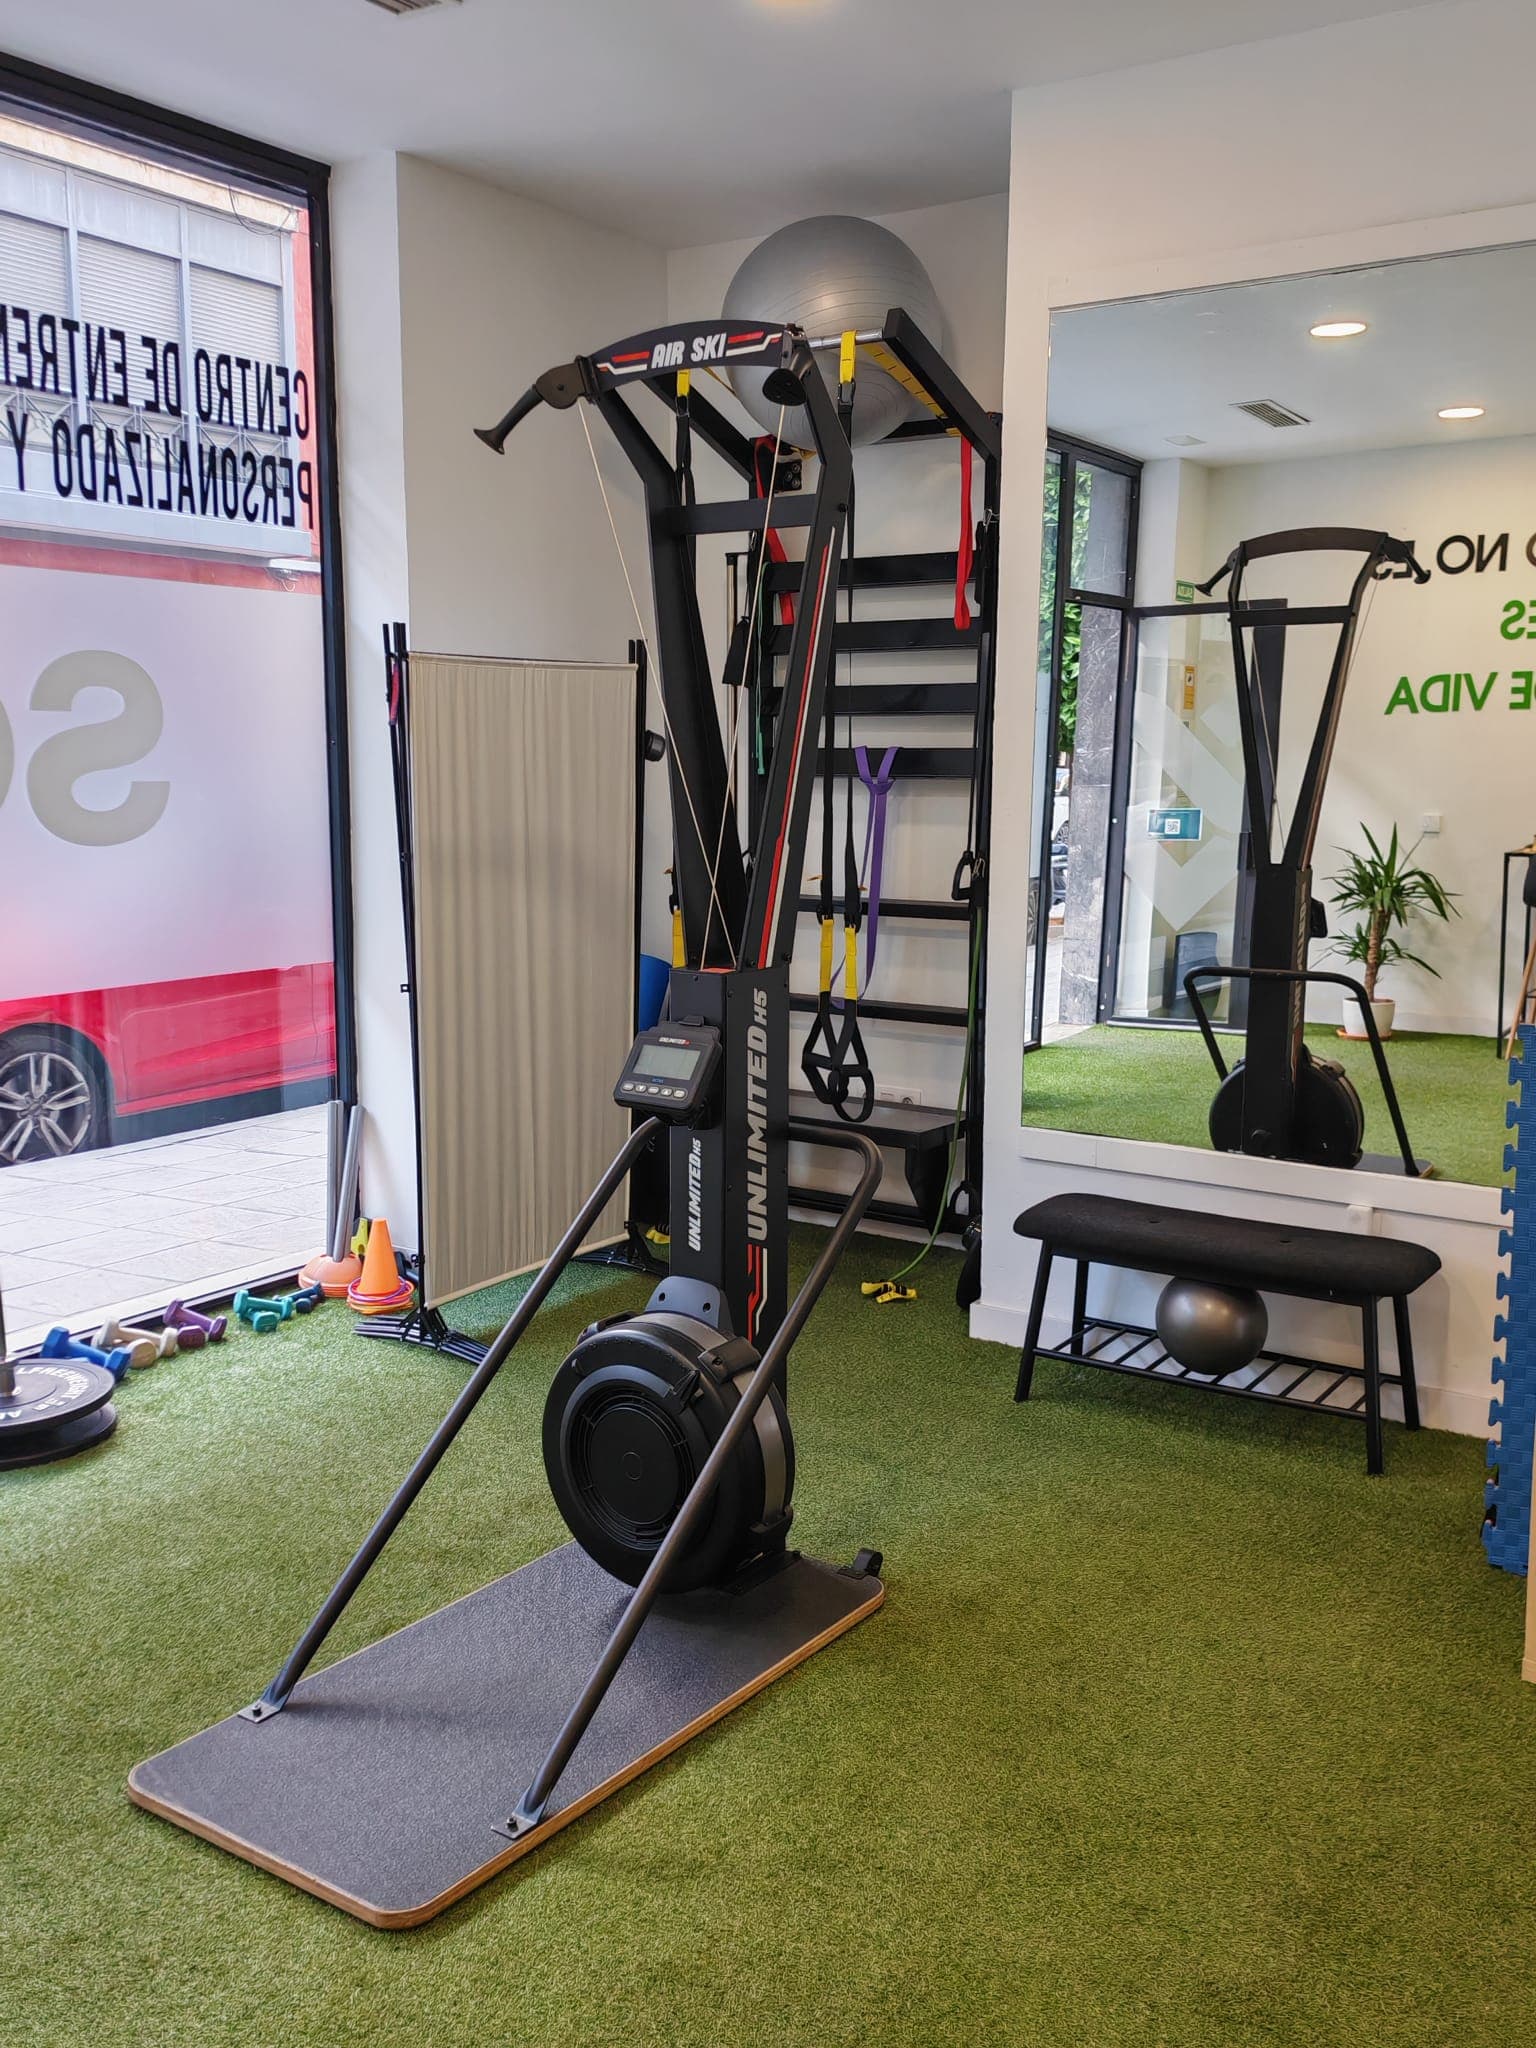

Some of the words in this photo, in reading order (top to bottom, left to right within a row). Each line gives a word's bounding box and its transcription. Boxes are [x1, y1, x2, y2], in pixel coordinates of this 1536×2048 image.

[651, 340, 686, 369] AIR
[690, 332, 727, 362] SKI
[747, 1025, 767, 1241] UNLIMITED
[688, 1152, 702, 1252] UNLIMITED
